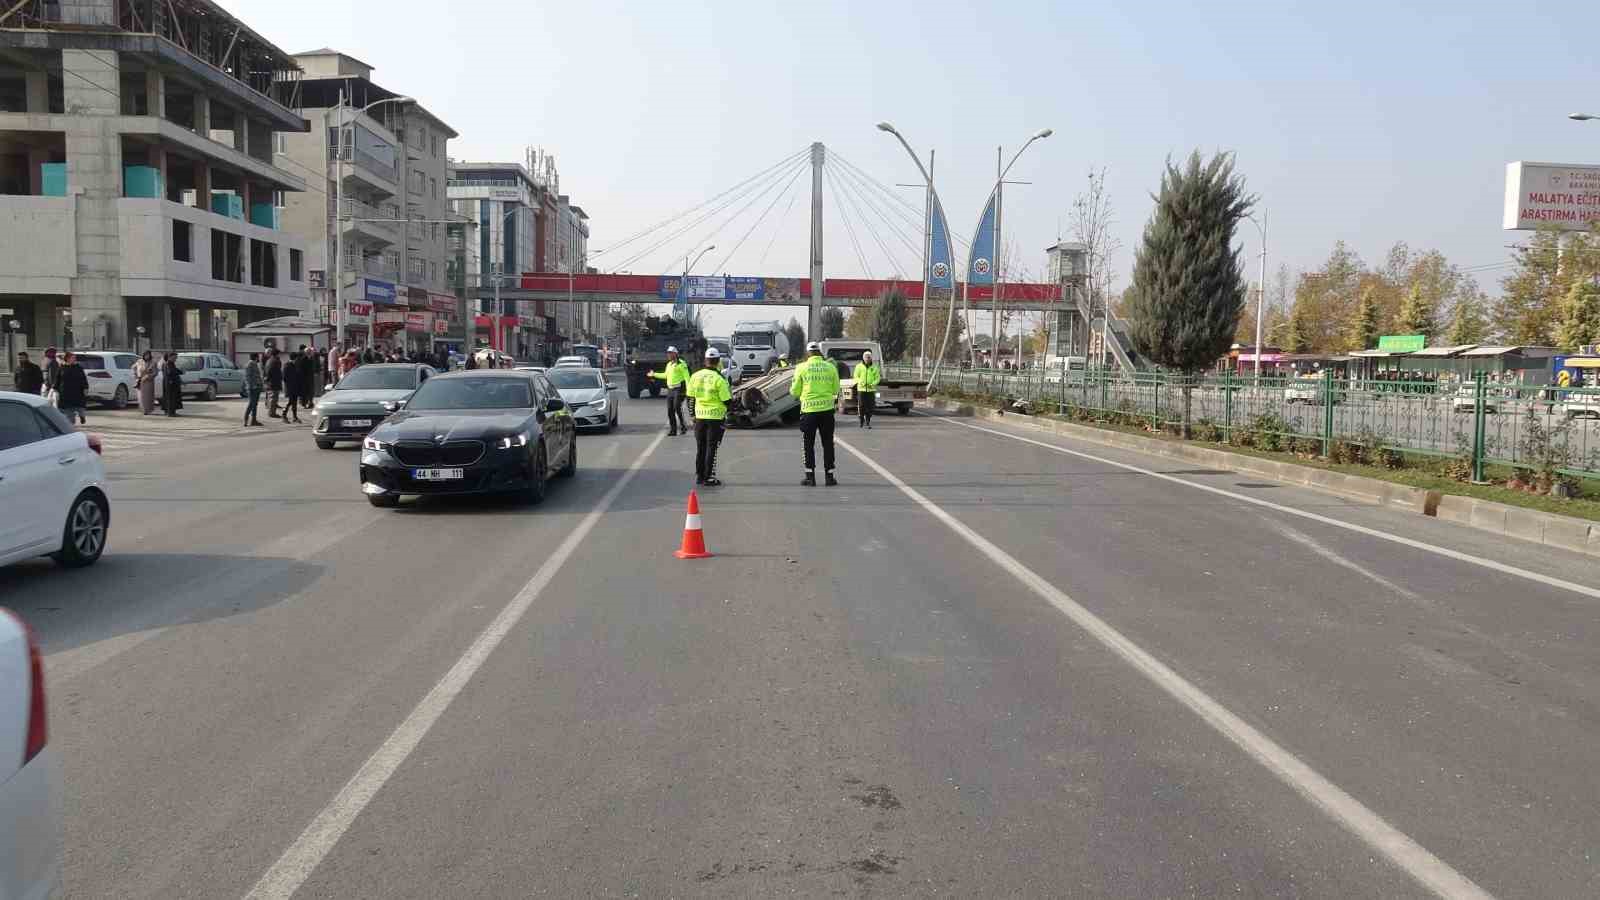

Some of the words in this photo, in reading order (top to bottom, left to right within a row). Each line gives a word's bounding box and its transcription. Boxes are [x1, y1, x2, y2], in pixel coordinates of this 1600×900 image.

[1529, 193, 1574, 204] MALATYA
[417, 470, 426, 478] 44
[452, 469, 463, 478] 111
